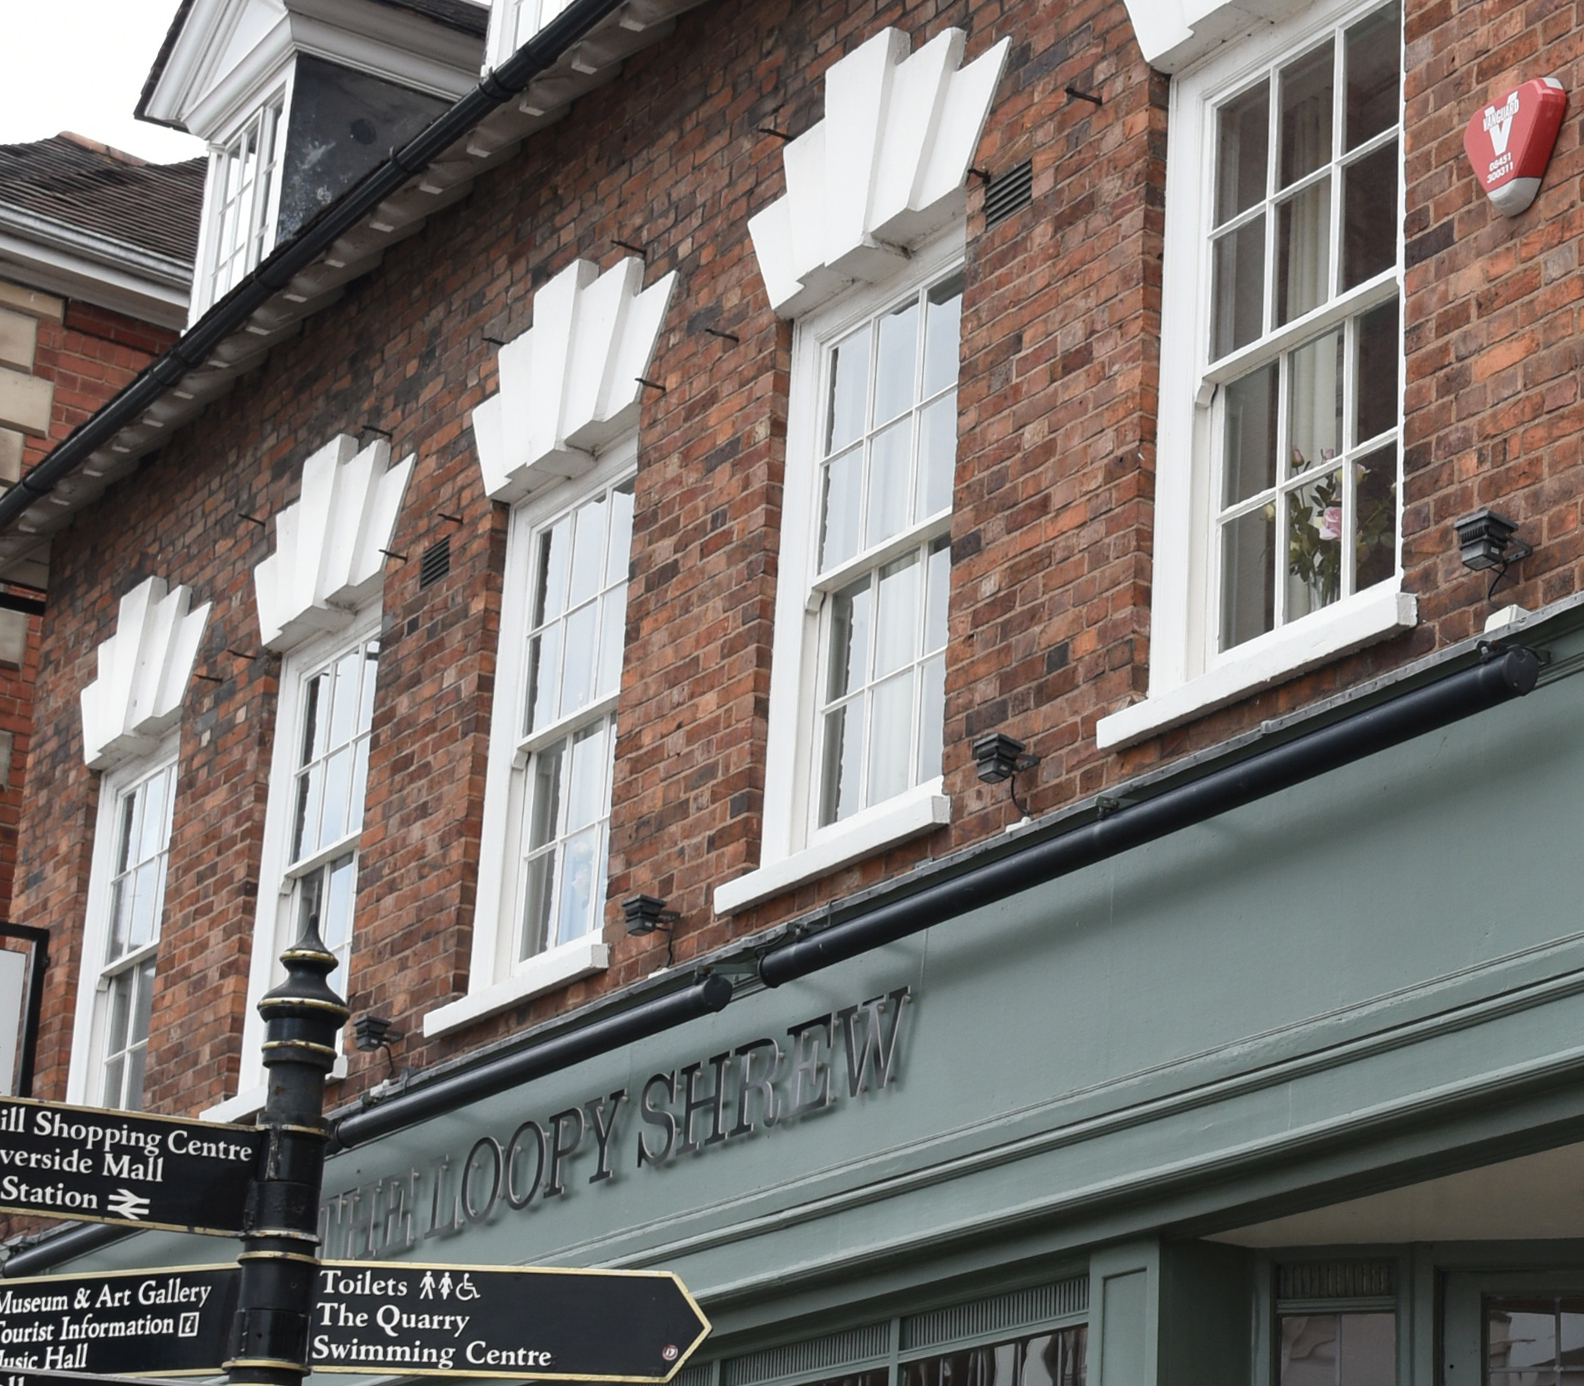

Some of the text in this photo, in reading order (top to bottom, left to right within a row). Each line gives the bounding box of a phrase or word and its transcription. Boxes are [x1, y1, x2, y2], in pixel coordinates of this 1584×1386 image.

[1483, 98, 1519, 132] VANGUARD
[33, 1110, 162, 1155] Shopping
[168, 1130, 253, 1162] Centre
[318, 985, 911, 1260] THE LOOPY SHREW
[102, 1153, 164, 1182] Mall
[0, 1175, 98, 1209] Station
[74, 1287, 91, 1309] &
[95, 1283, 131, 1308] Art
[138, 1277, 212, 1308] Gallery
[319, 1269, 408, 1296] Toilets
[59, 1313, 174, 1341] Information
[316, 1302, 470, 1338] The Quarry
[43, 1343, 89, 1370] Hall
[311, 1336, 553, 1370] Swimming Centre
